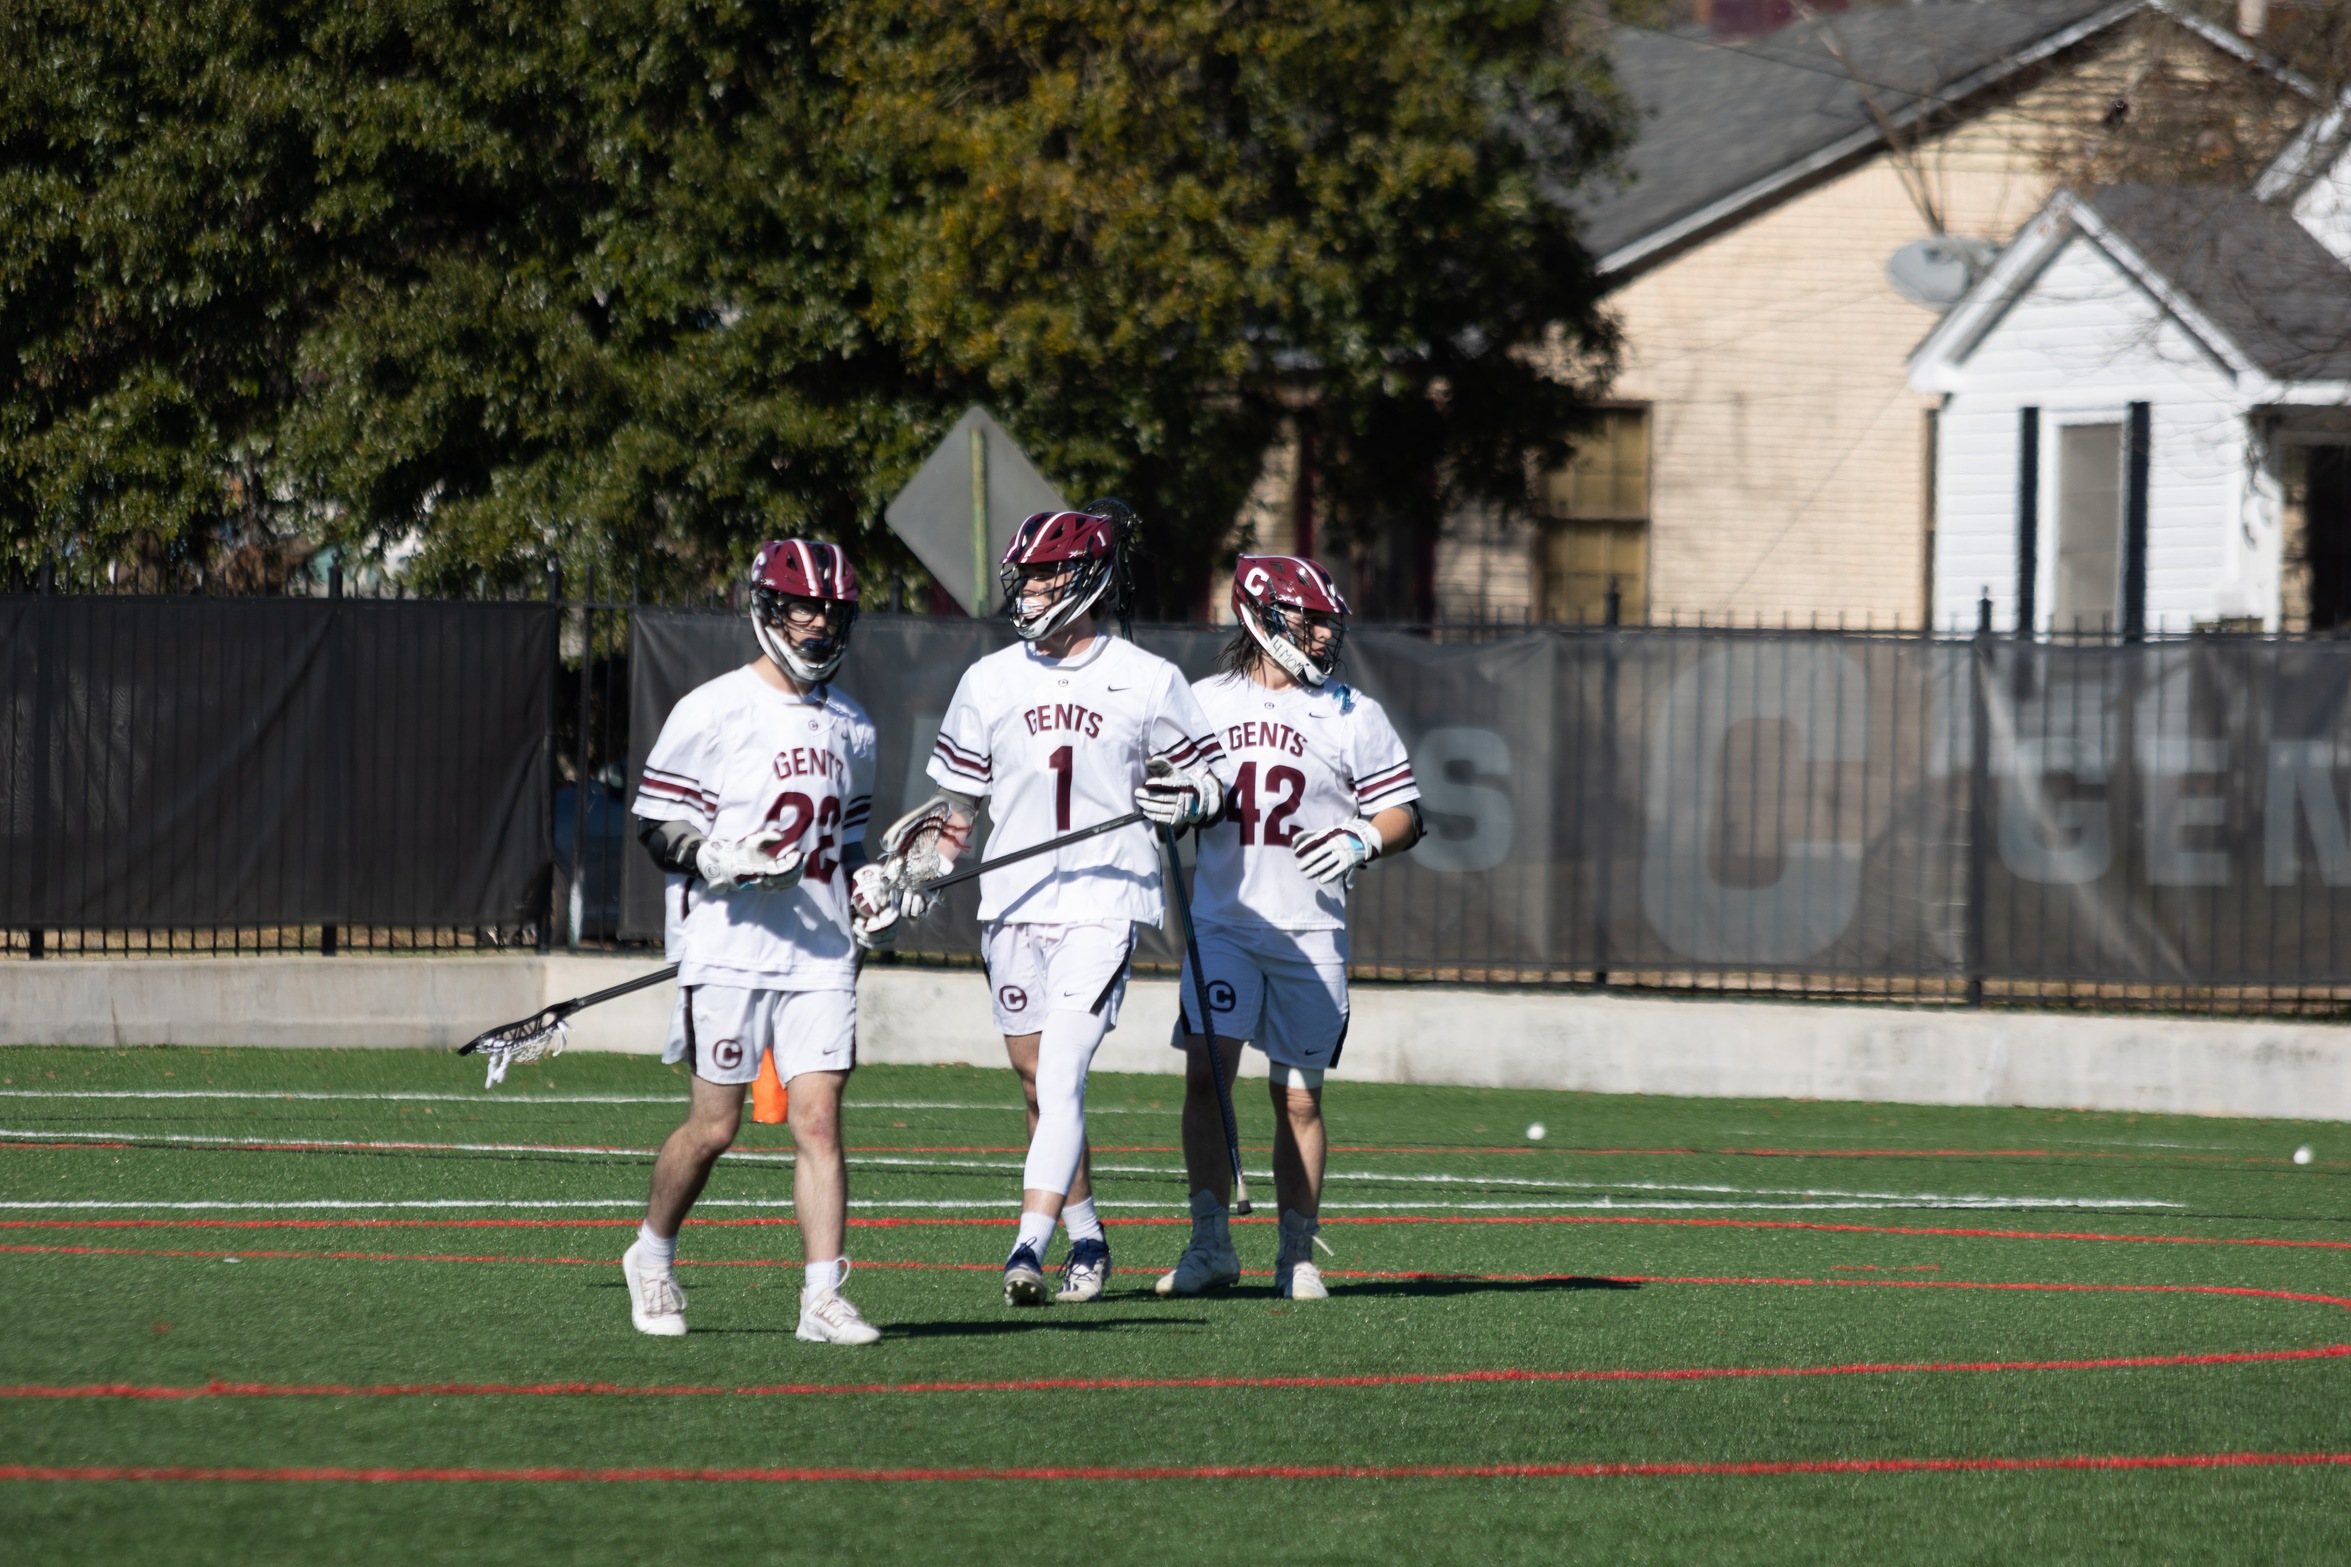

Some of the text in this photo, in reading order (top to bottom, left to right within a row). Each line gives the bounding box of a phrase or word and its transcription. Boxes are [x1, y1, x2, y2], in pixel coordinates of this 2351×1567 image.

[1244, 567, 1269, 597] C
[1272, 639, 1304, 675] 4 MOM
[1023, 703, 1104, 739] GENTS
[1228, 721, 1308, 758] GENTS
[1049, 745, 1073, 831] 1
[1226, 761, 1306, 847] 42
[1641, 642, 1868, 963] C
[764, 791, 841, 885] 22
[999, 985, 1027, 1013] C
[1206, 980, 1236, 1013] C
[713, 1038, 743, 1070] C
